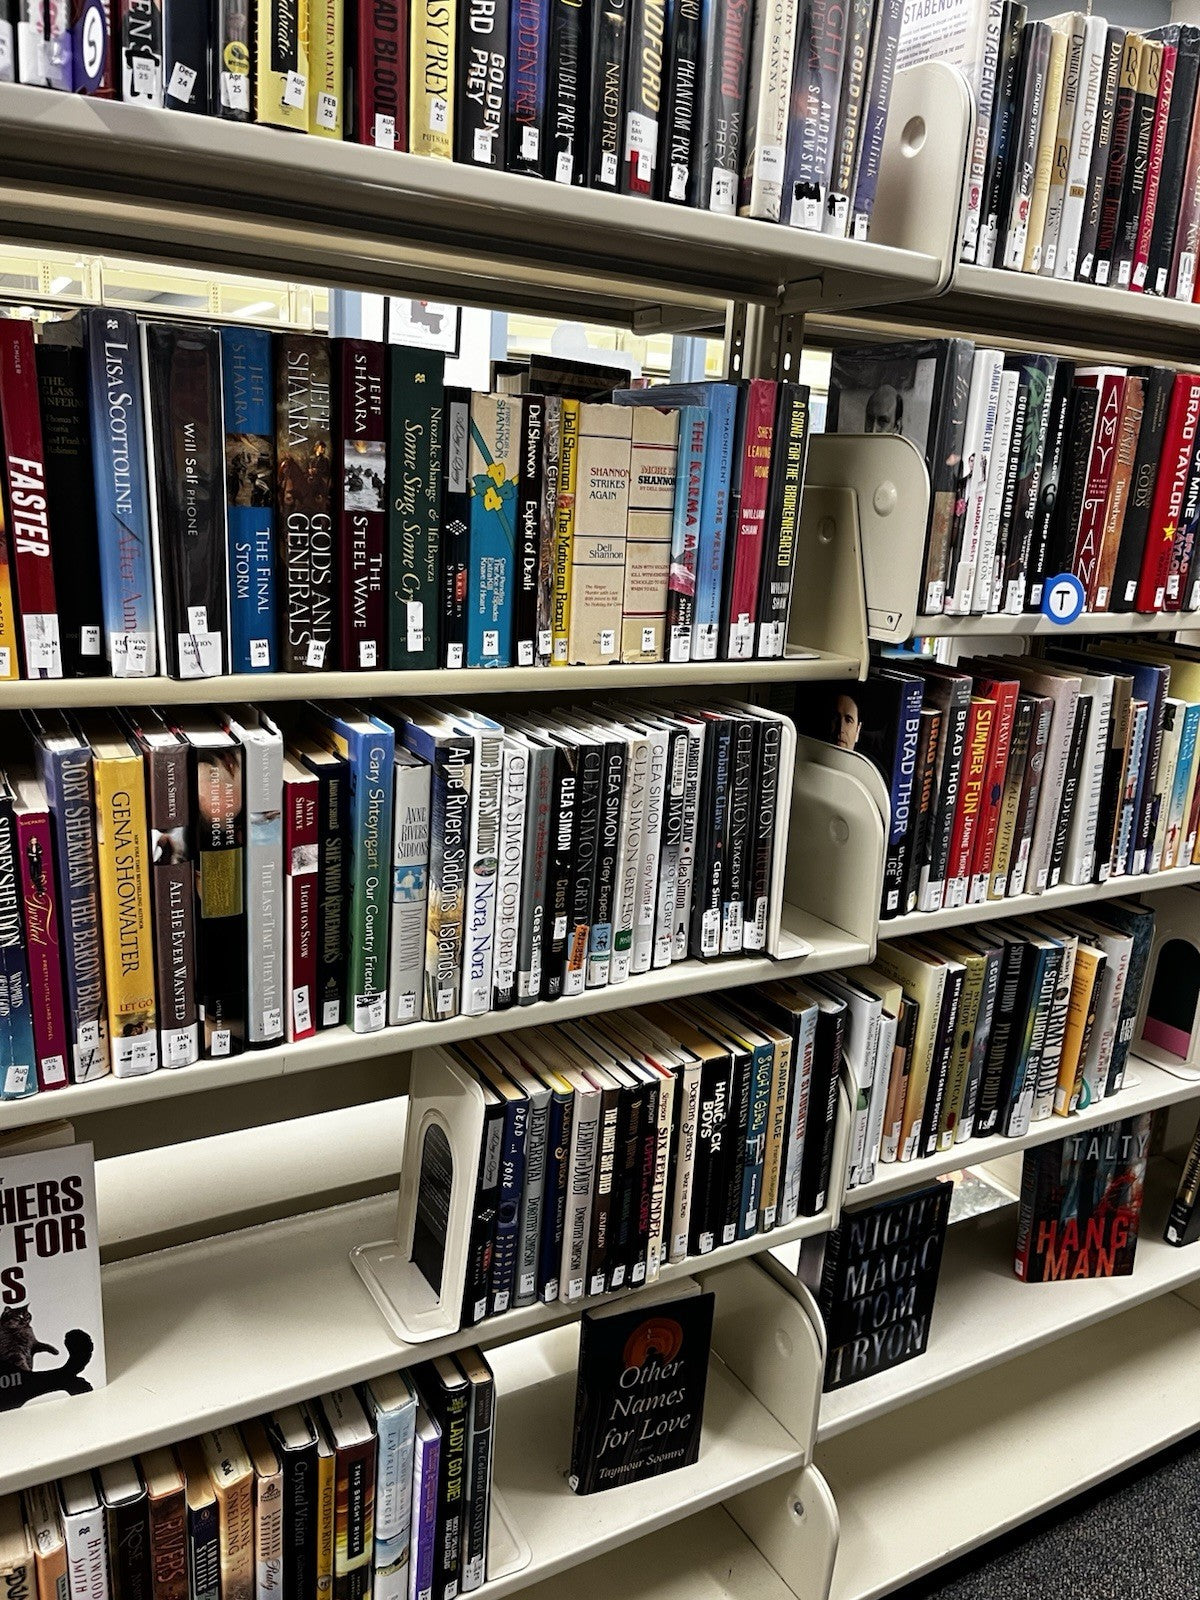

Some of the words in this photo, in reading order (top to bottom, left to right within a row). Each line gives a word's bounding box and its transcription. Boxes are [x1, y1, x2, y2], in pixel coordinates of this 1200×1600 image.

[178, 77, 188, 88] 24
[179, 64, 194, 80] Dec
[425, 39, 450, 102] PREY
[467, 47, 489, 105] PREY
[602, 62, 619, 118] NAKED
[875, 34, 898, 116] Bernhard
[980, 24, 999, 118] STABENOW
[1102, 41, 1122, 107] DANIELLE
[323, 96, 336, 107] FEB
[324, 107, 333, 118] 25
[776, 51, 790, 145] HARVEST
[1031, 73, 1042, 115] RICHARD
[815, 101, 831, 175] ANDRZEJ
[866, 116, 884, 178] Schlink
[973, 126, 988, 160] Bad
[1026, 118, 1037, 148] STARK
[1098, 110, 1112, 148] STEEL
[1088, 176, 1102, 227] LEGACY
[104, 341, 129, 387] LISA
[232, 344, 248, 426] SHAARA
[249, 364, 264, 406] JEFF
[287, 351, 309, 447] SHAARA
[310, 372, 330, 432] JEFF
[355, 354, 366, 434] SHAARA
[370, 375, 381, 416] JEFF
[793, 401, 804, 409] A
[1182, 386, 1200, 440] BRAD
[184, 422, 196, 453] Will
[563, 411, 576, 433] Dell
[692, 421, 705, 453] THE
[790, 409, 805, 438] SONG
[1118, 405, 1143, 466] Pursuit
[108, 392, 133, 515] SCOTTOLINE
[404, 419, 423, 473] Some
[561, 435, 576, 491] Shannon
[788, 442, 801, 459] FOR
[185, 458, 198, 484] Self
[590, 479, 625, 489] STRIKES
[785, 459, 800, 481] THE
[1135, 464, 1151, 508] GODS
[1168, 444, 1190, 517] TAYLOR
[9, 455, 49, 558] FASTER
[187, 488, 198, 536] PHONE
[589, 491, 616, 500] AGAIN
[685, 461, 701, 525] KARMA
[1107, 478, 1126, 534] Tanneberg
[403, 514, 421, 569] Some
[559, 510, 572, 532] The
[777, 485, 797, 567] BROKENHEARTED
[256, 528, 270, 563] THE
[311, 513, 332, 585] GODS
[353, 517, 368, 572] STEEL
[556, 534, 572, 574] Motive
[589, 550, 623, 559] Shannon
[597, 543, 612, 552] Dell
[683, 534, 696, 574] MAP
[236, 543, 250, 600] STORM
[257, 566, 271, 614] FINAL
[287, 512, 310, 646] GENERALS
[370, 553, 381, 591] THE
[396, 571, 422, 605] Cry
[555, 576, 569, 590] on
[353, 576, 366, 628] WAVE
[553, 592, 568, 632] Record
[1055, 590, 1070, 610] T
[255, 642, 267, 650] JAN
[363, 642, 375, 650] JAN
[366, 651, 374, 659] 25
[762, 727, 780, 776] CLEA
[900, 719, 920, 776] BRAD
[952, 710, 968, 762] BRAD
[969, 710, 992, 775] SUMMER
[995, 694, 1013, 768] LEARWIFE
[60, 760, 88, 802] JORY
[366, 747, 385, 789] Gary
[446, 746, 471, 789] Anne
[507, 756, 525, 809] CLEA
[607, 754, 622, 796] CLEA
[650, 745, 663, 783] CLEA
[946, 765, 961, 805] THOR
[560, 777, 576, 810] CLEA
[647, 786, 661, 835] SIMON
[758, 779, 776, 839] SIMON
[894, 779, 911, 836] THOR
[963, 780, 983, 815] FUN
[111, 790, 131, 851] GENA
[364, 789, 385, 872] Shteyngart
[401, 824, 429, 841] RIVERS
[405, 806, 427, 826] ANNE
[443, 792, 467, 846] Rivers
[557, 812, 573, 851] SIMON
[603, 799, 619, 847] SIMON
[64, 807, 93, 888] SHERMAN
[503, 812, 522, 878] SIMON
[366, 876, 379, 900] Our
[440, 850, 465, 913] Siddons
[679, 856, 692, 880] Clea
[70, 893, 96, 929] THE
[170, 880, 183, 905] ALL
[472, 883, 495, 932] Nora,
[501, 881, 518, 925] CODE
[676, 879, 690, 909] Simon
[115, 856, 140, 978] SHOWALTER
[171, 908, 184, 928] HE
[363, 903, 379, 954] Country
[73, 931, 98, 984] BARON
[172, 931, 187, 962] EVER
[435, 920, 459, 982] Islands
[470, 935, 491, 981] Nora
[174, 965, 189, 1021] WANTED
[297, 993, 304, 1003] S
[1111, 953, 1128, 1009] UNQUIET
[1045, 1003, 1063, 1050] ARMY
[803, 1042, 813, 1076] KARIN
[1097, 1031, 1110, 1074] ULLMANN
[777, 1061, 788, 1103] SAVAGE
[1038, 1053, 1061, 1098] BLUE
[605, 1107, 618, 1125] THE
[701, 1100, 714, 1138] BOYS
[773, 1106, 784, 1139] PLACE
[796, 1080, 811, 1140] SLAUGHTER
[602, 1126, 616, 1153] NIGHT
[658, 1128, 668, 1148] SIX
[1072, 1134, 1149, 1161] TALTY
[599, 1173, 614, 1195] DIED
[601, 1154, 614, 1172] SHE
[656, 1154, 668, 1186] FEET
[648, 1190, 664, 1238] UNDER
[1037, 1216, 1130, 1254] HANG
[14, 1214, 87, 1264] FOR
[844, 1234, 940, 1300] MAGIC
[1042, 1250, 1116, 1281] MAN
[852, 1286, 916, 1336] TOM
[831, 1314, 927, 1384] TRYON
[619, 1360, 684, 1389] Other
[609, 1387, 686, 1421] Names
[596, 1428, 635, 1458] for
[639, 1413, 691, 1442] Love
[599, 1460, 644, 1479] Taymour
[646, 1447, 685, 1467] Soomro
[87, 1538, 103, 1600] HAYWOOD
[154, 1516, 184, 1583] RIVERS
[71, 1557, 88, 1593] SMITH
